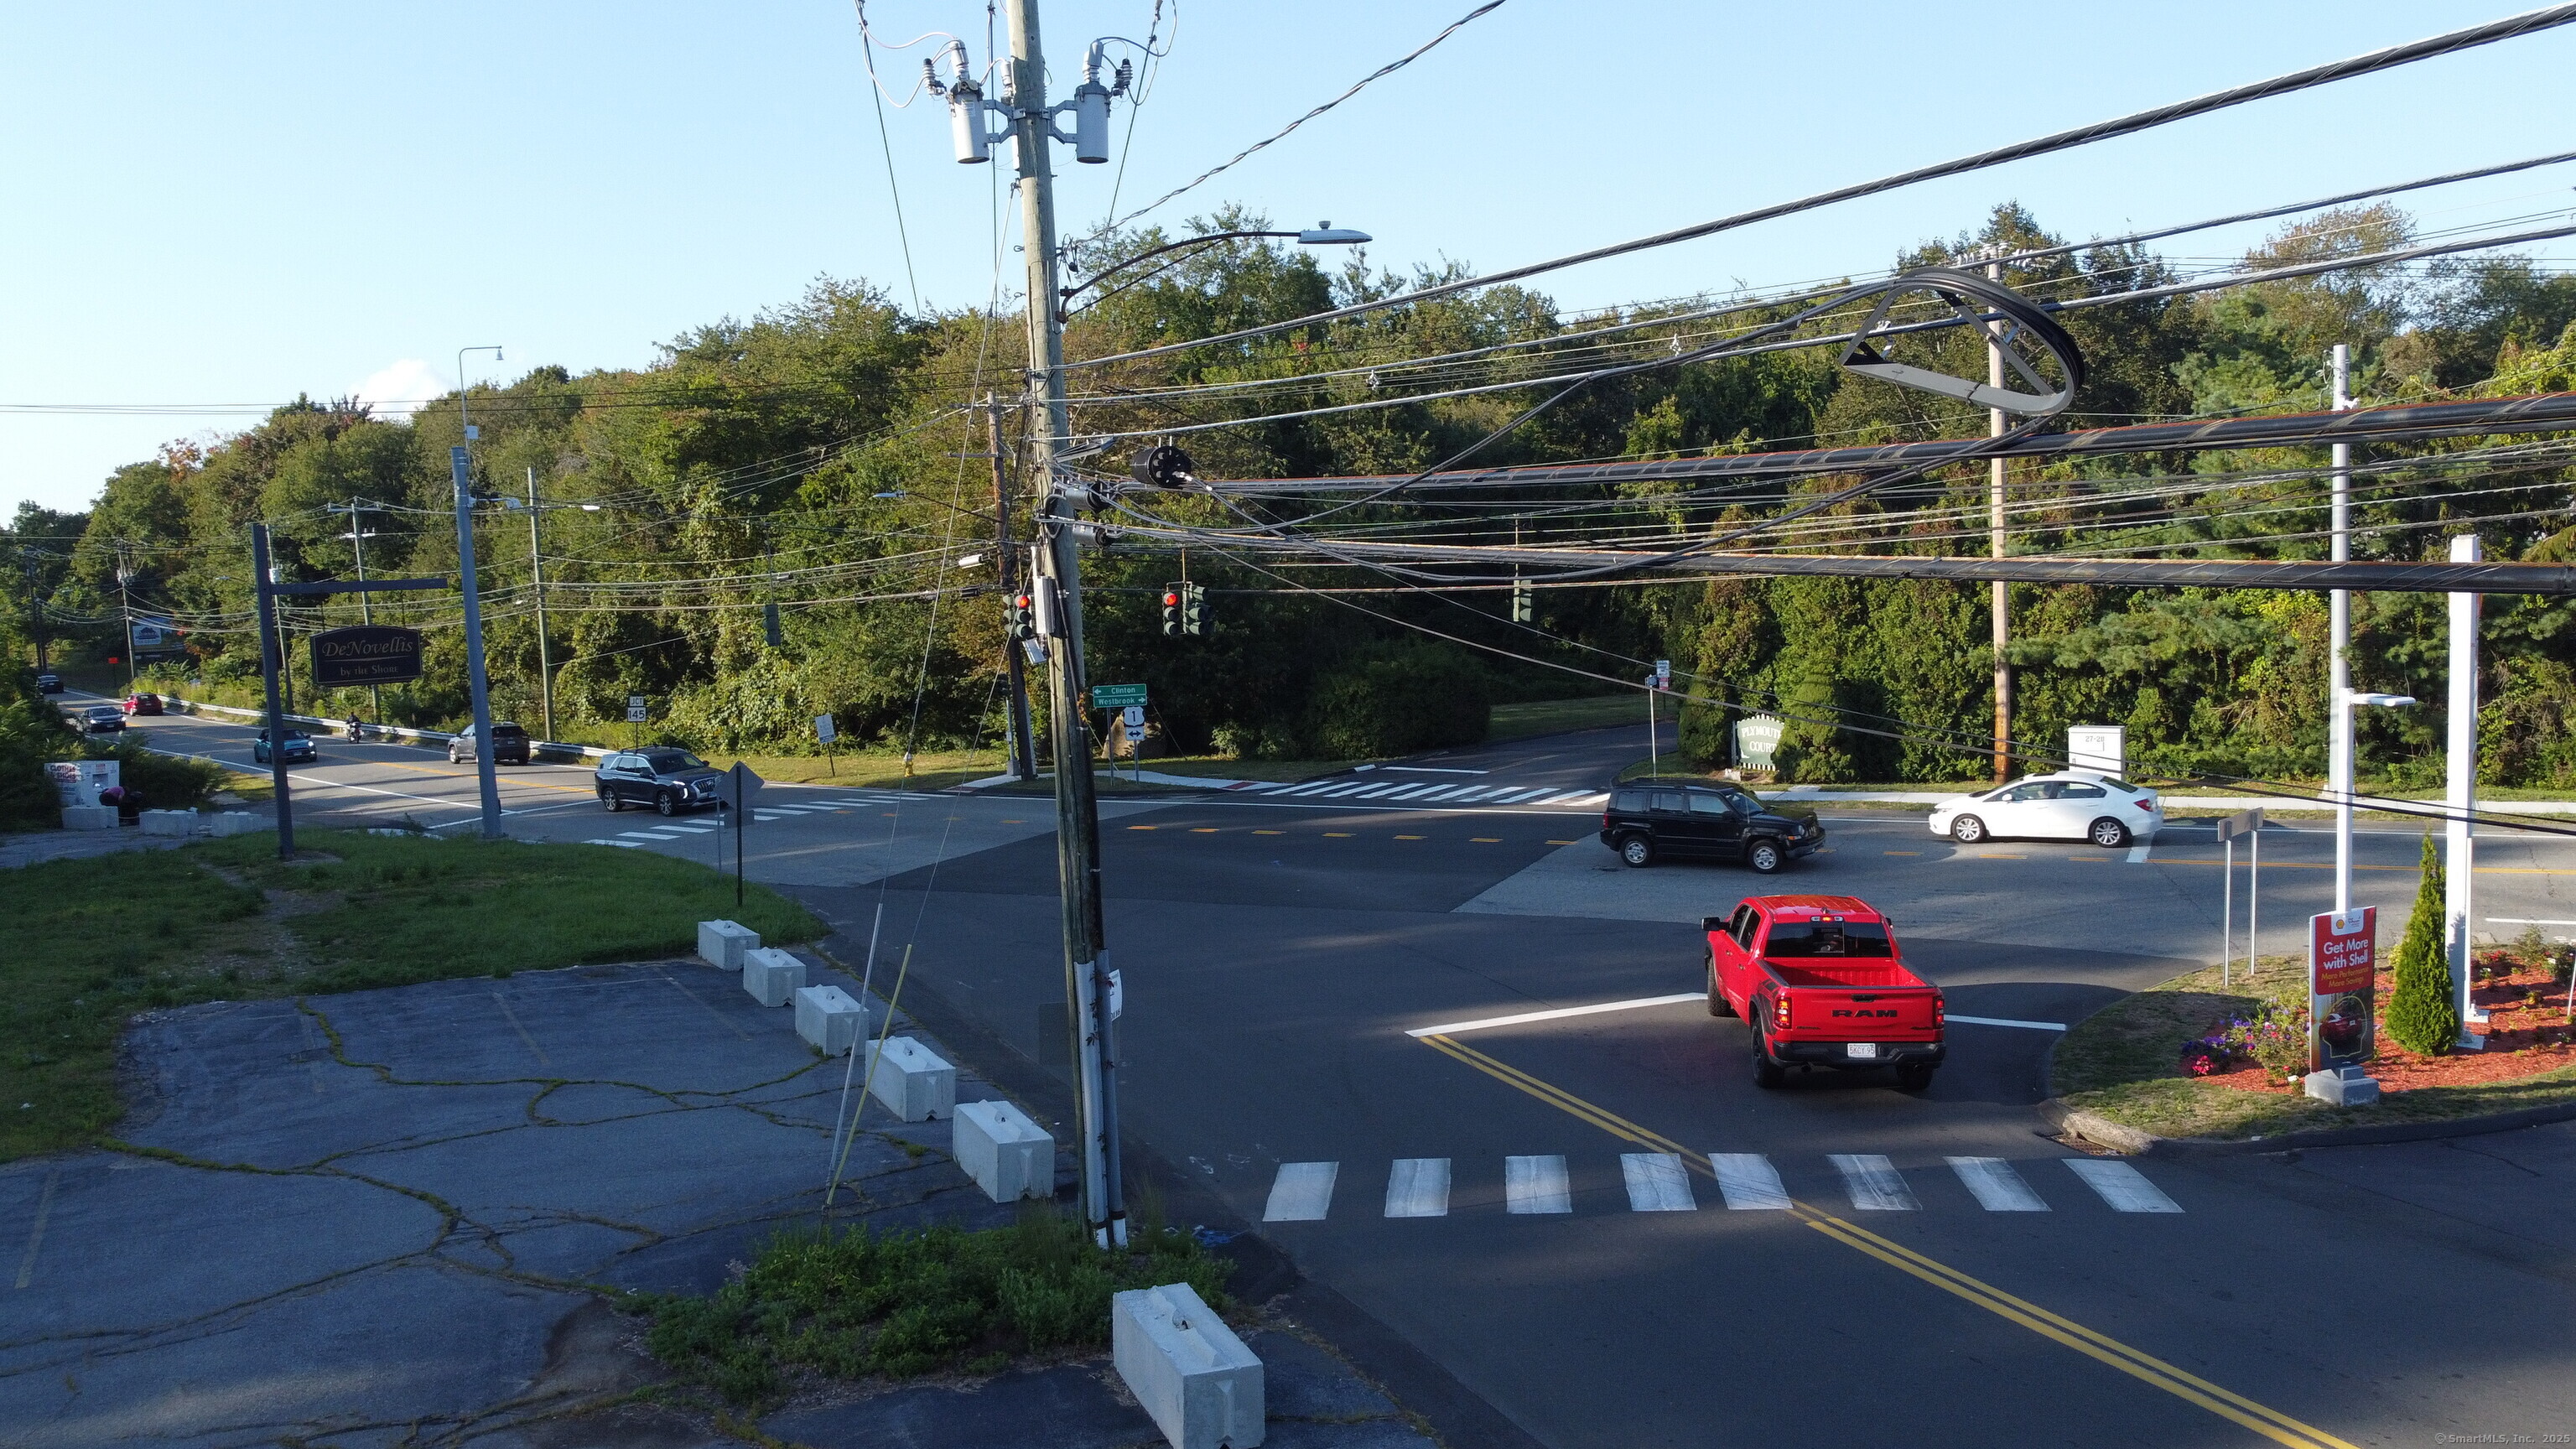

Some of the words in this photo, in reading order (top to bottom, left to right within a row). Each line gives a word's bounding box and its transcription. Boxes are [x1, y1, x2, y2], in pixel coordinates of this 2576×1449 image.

[321, 636, 413, 657] DeNovellis
[340, 667, 351, 677] by
[1098, 697, 1135, 706] Westbrook
[628, 709, 645, 719] 145
[1131, 710, 1136, 722] 1
[2324, 942, 2344, 954] Get
[2346, 938, 2369, 952] More
[2324, 954, 2347, 969] with
[2349, 949, 2368, 967] Shell
[2321, 973, 2338, 981] More
[2329, 979, 2345, 988] More
[1831, 1010, 1898, 1018] RAM
